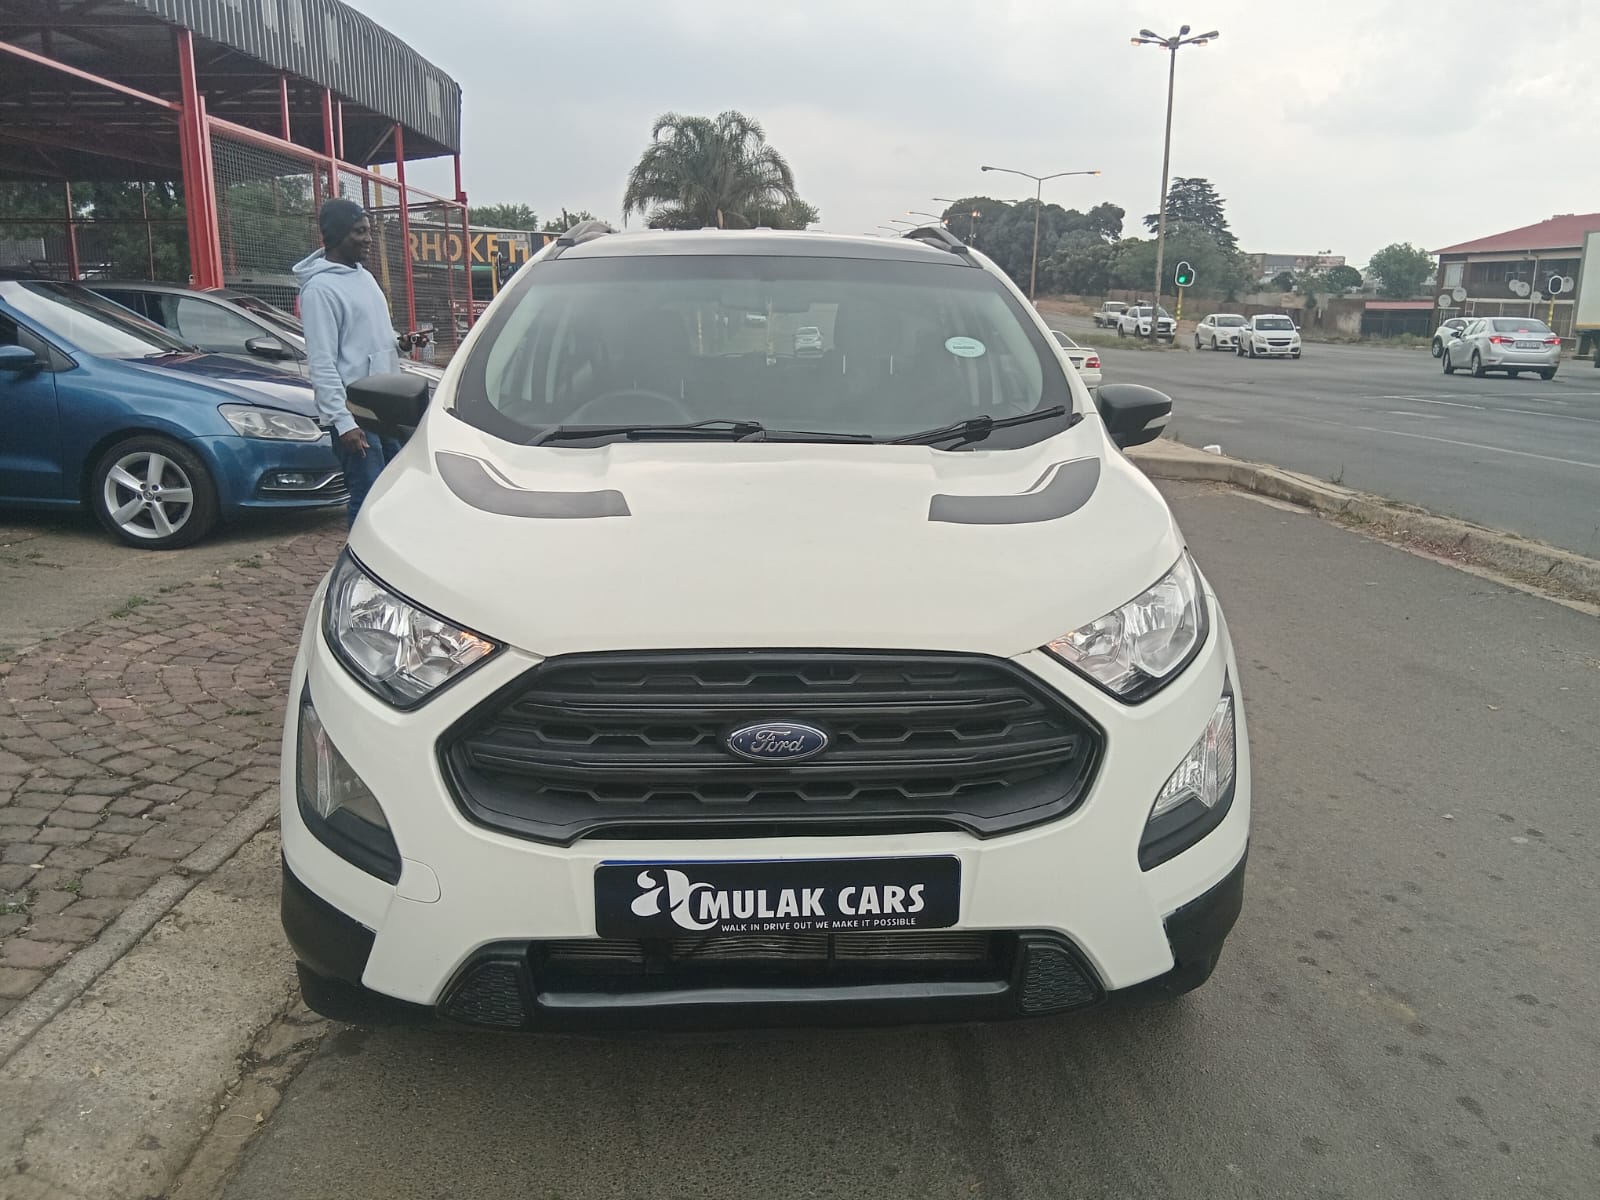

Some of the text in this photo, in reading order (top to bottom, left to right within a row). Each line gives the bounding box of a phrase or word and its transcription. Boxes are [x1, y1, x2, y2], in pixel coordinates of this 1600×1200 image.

[751, 730, 805, 753] Ford
[700, 887, 826, 920] MULAK
[837, 883, 926, 916] CARS
[721, 917, 917, 932] WALK IN DRIVE OUT WE MAKE IT POSSIBLE
